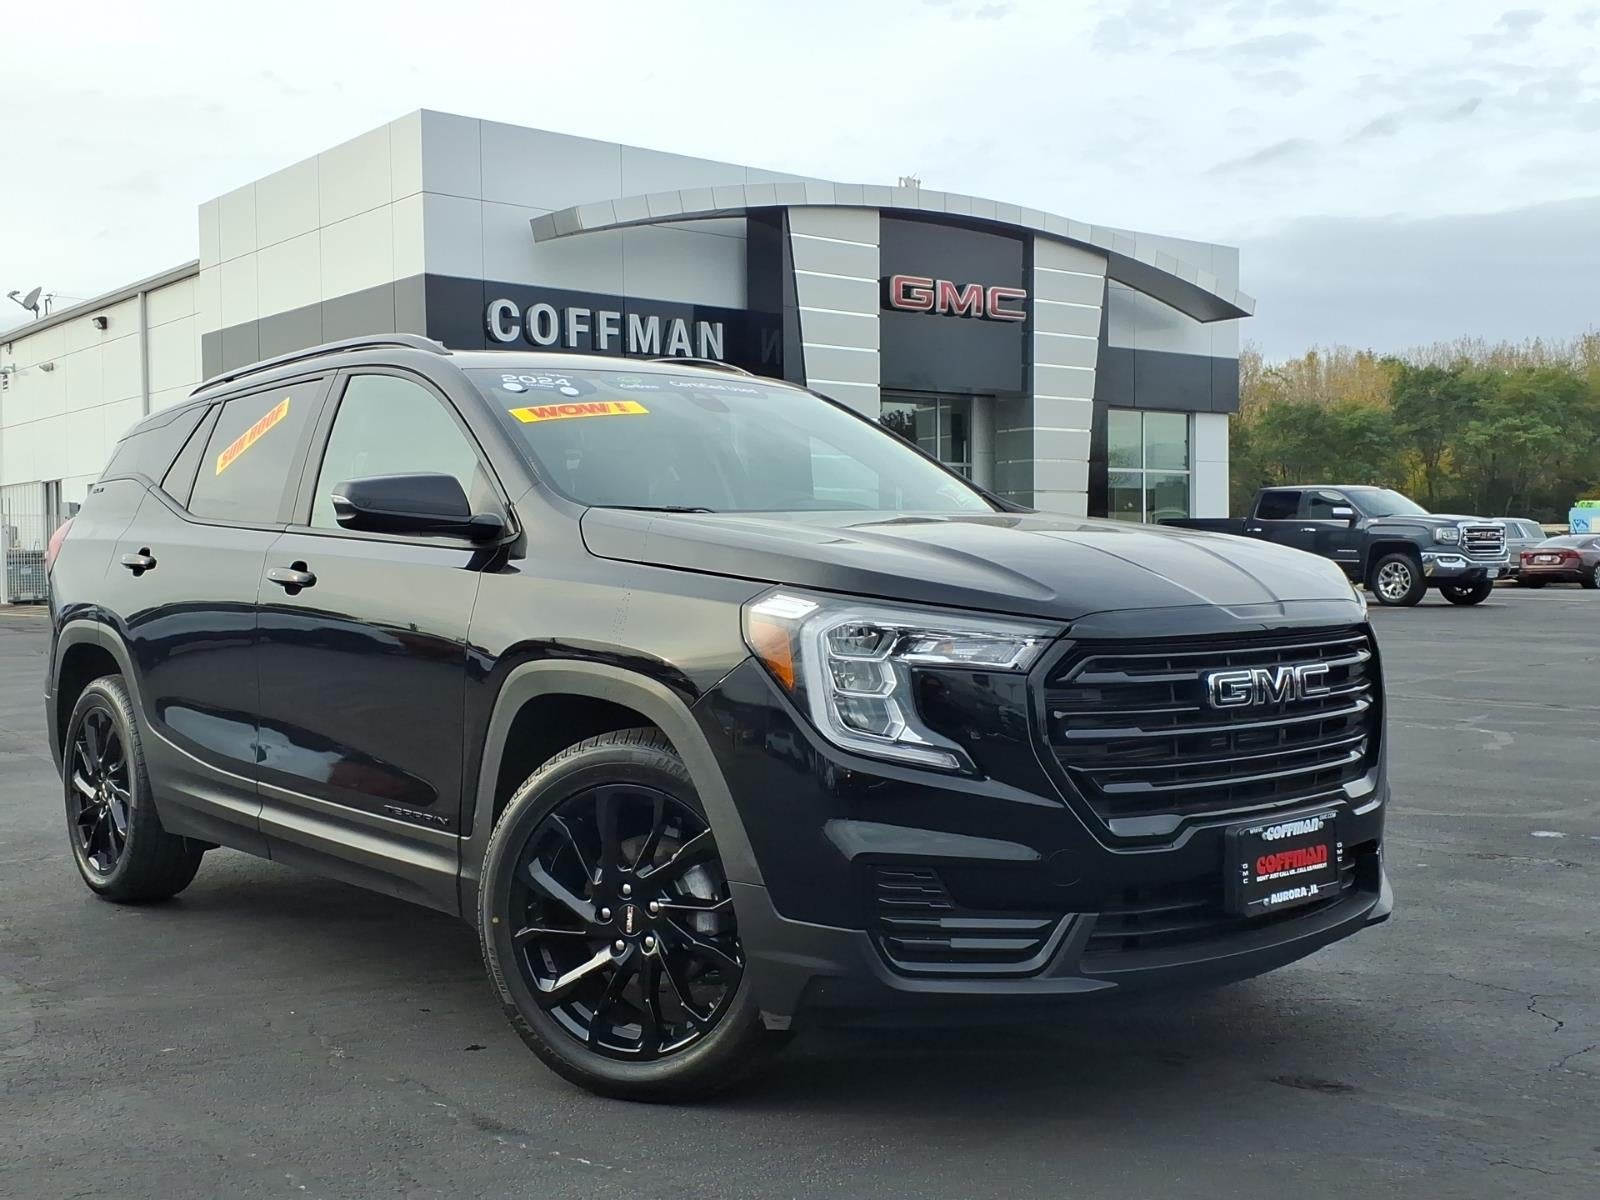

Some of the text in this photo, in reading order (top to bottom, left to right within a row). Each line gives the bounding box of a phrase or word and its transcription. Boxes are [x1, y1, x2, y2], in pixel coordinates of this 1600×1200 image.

[889, 274, 1027, 322] GMC
[486, 298, 724, 360] COFFMAN
[501, 373, 571, 387] 2024
[1207, 664, 1331, 709] GMC
[1266, 818, 1319, 841] COFFMAN
[1256, 844, 1328, 875] COFFMAN
[1270, 887, 1307, 904] AURORA
